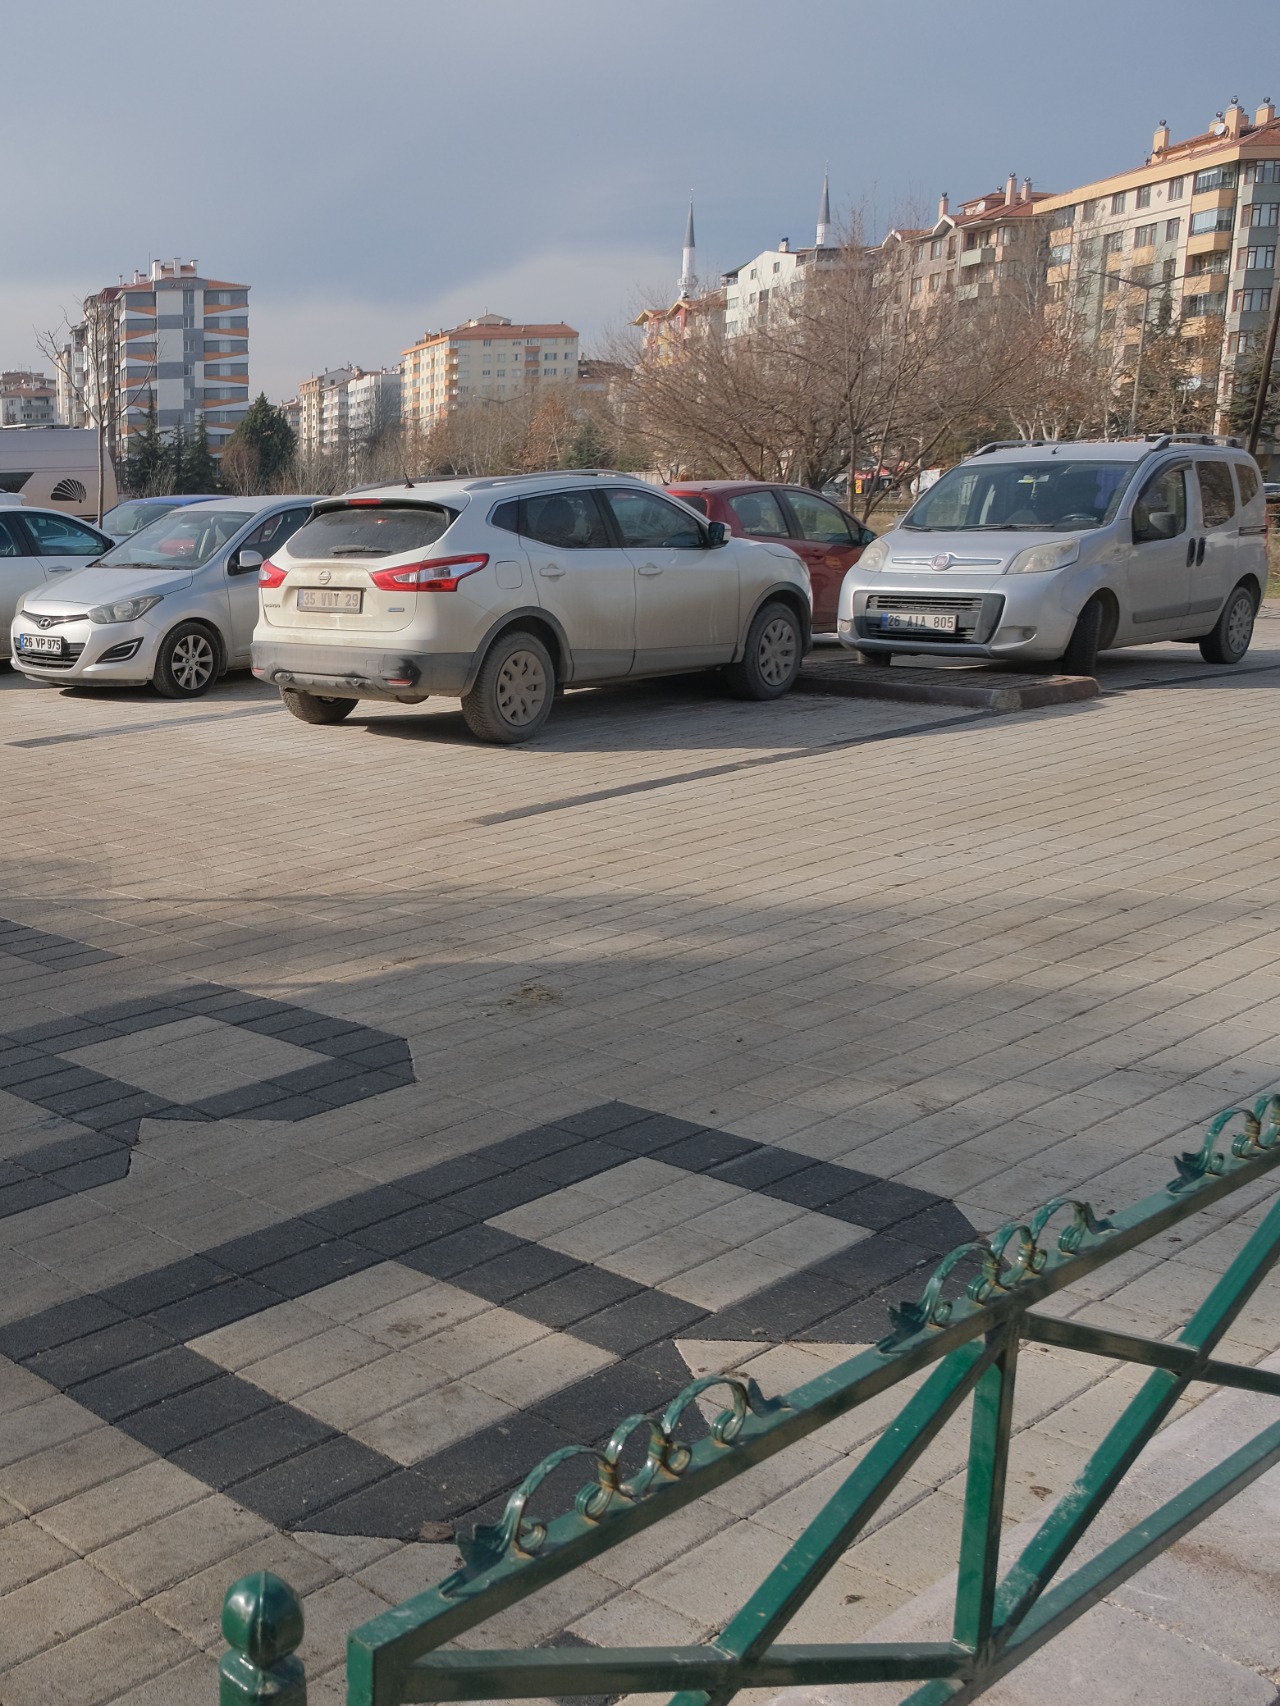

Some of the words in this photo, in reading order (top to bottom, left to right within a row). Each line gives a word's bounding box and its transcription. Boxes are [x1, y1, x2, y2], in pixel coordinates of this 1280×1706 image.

[304, 592, 316, 606] 35
[345, 593, 359, 607] 29
[888, 614, 900, 627] 26
[906, 615, 926, 627] AIA
[933, 616, 954, 628] 805
[24, 636, 33, 648] 26
[36, 637, 46, 649] VP
[47, 638, 61, 650] 975
